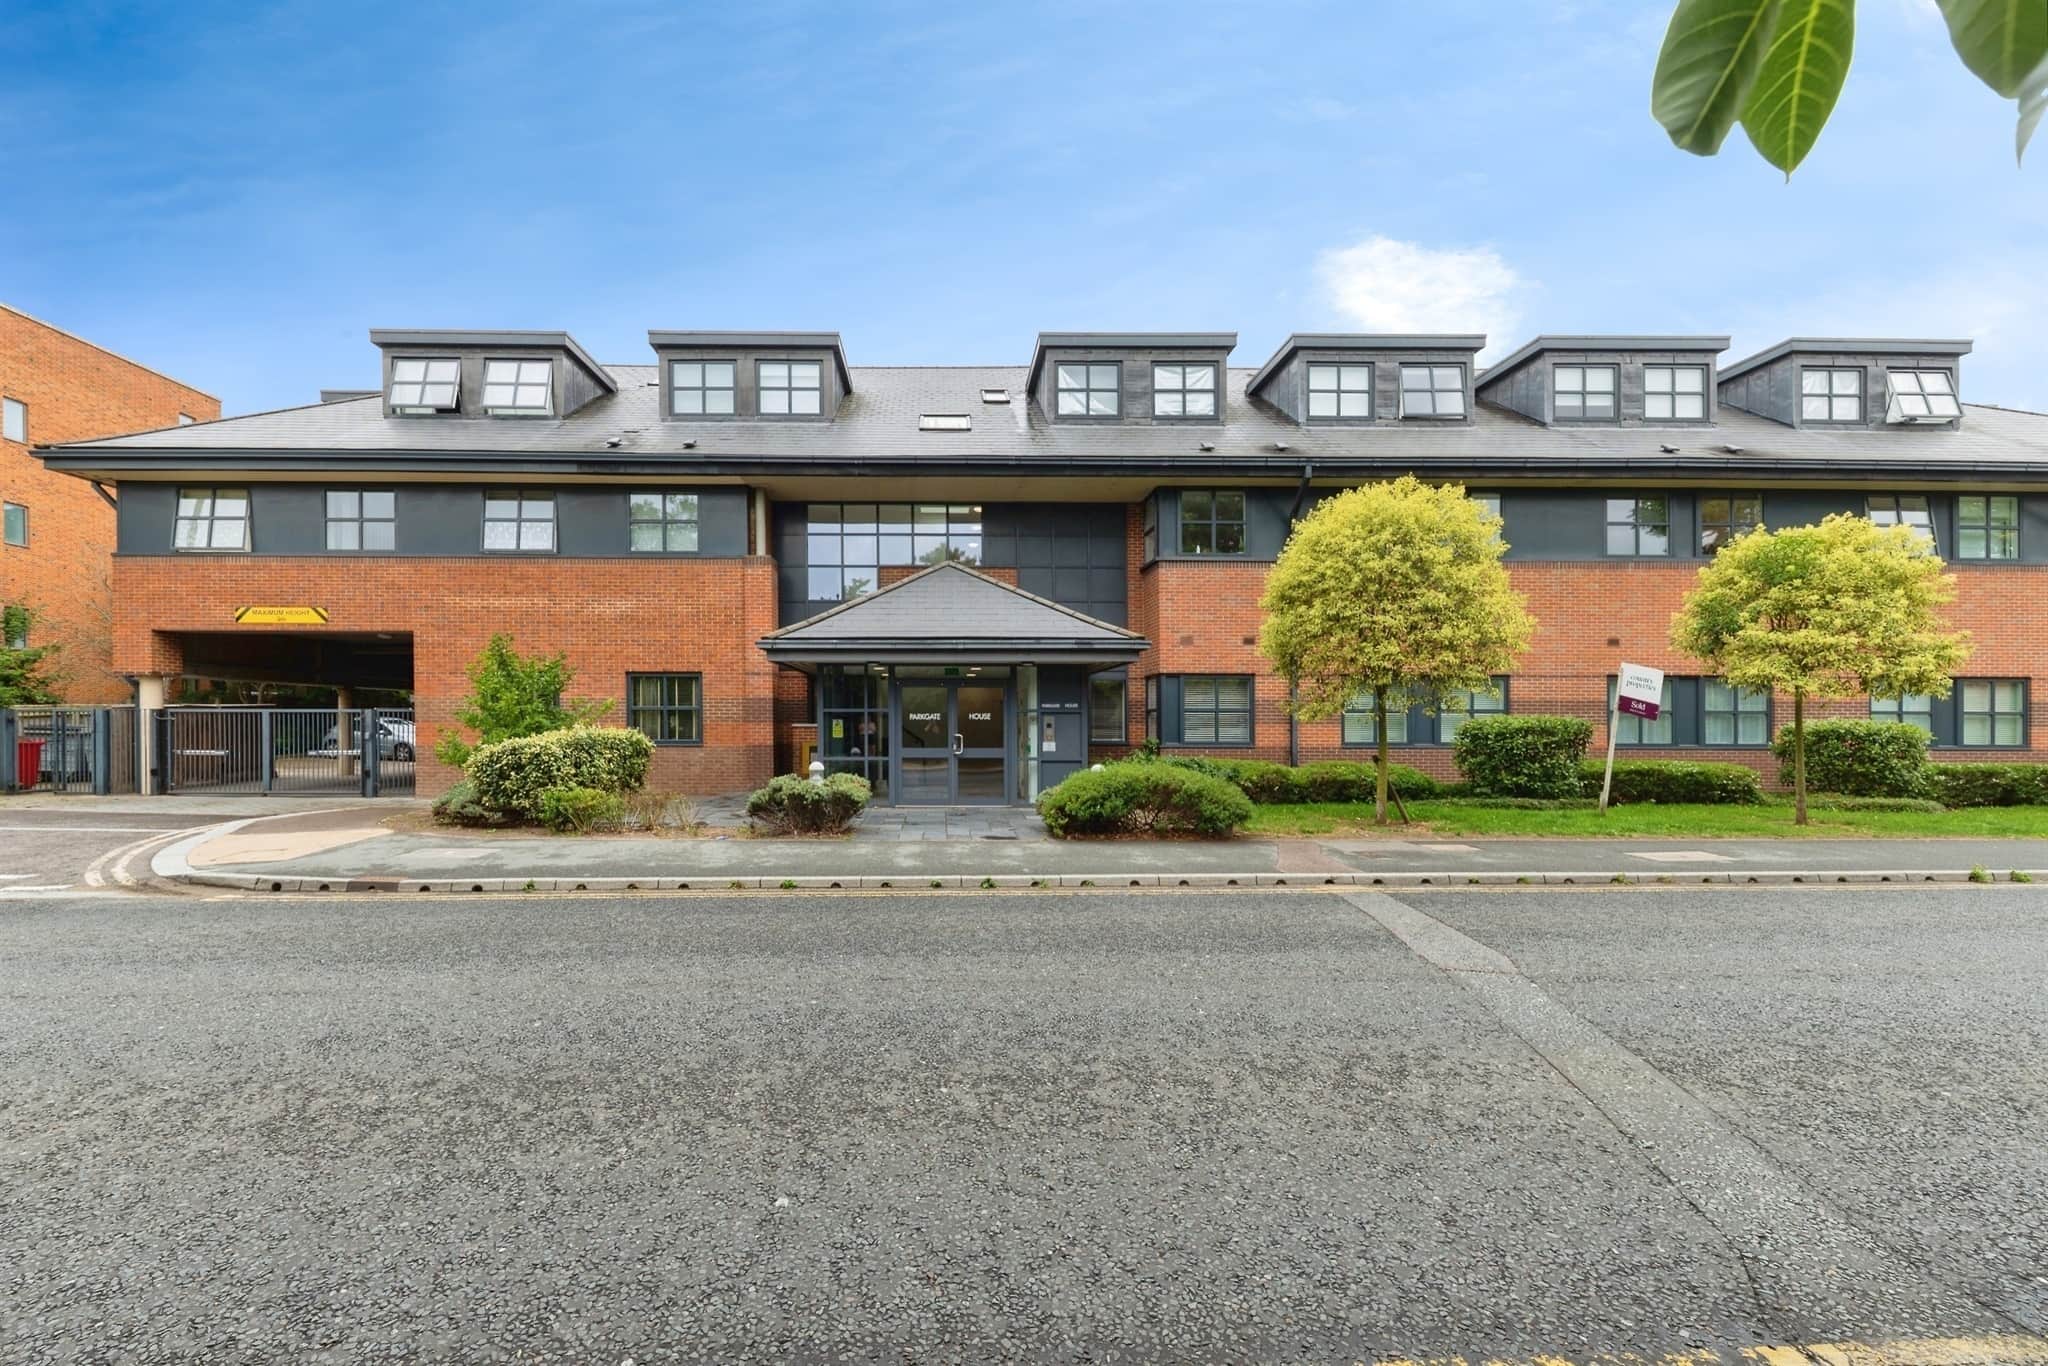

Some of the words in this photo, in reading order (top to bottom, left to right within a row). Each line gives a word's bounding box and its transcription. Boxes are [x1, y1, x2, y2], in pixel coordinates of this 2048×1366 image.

[1631, 701, 1646, 711] Sold
[909, 713, 941, 721] PARKGATE
[968, 713, 991, 721] HOUSE
